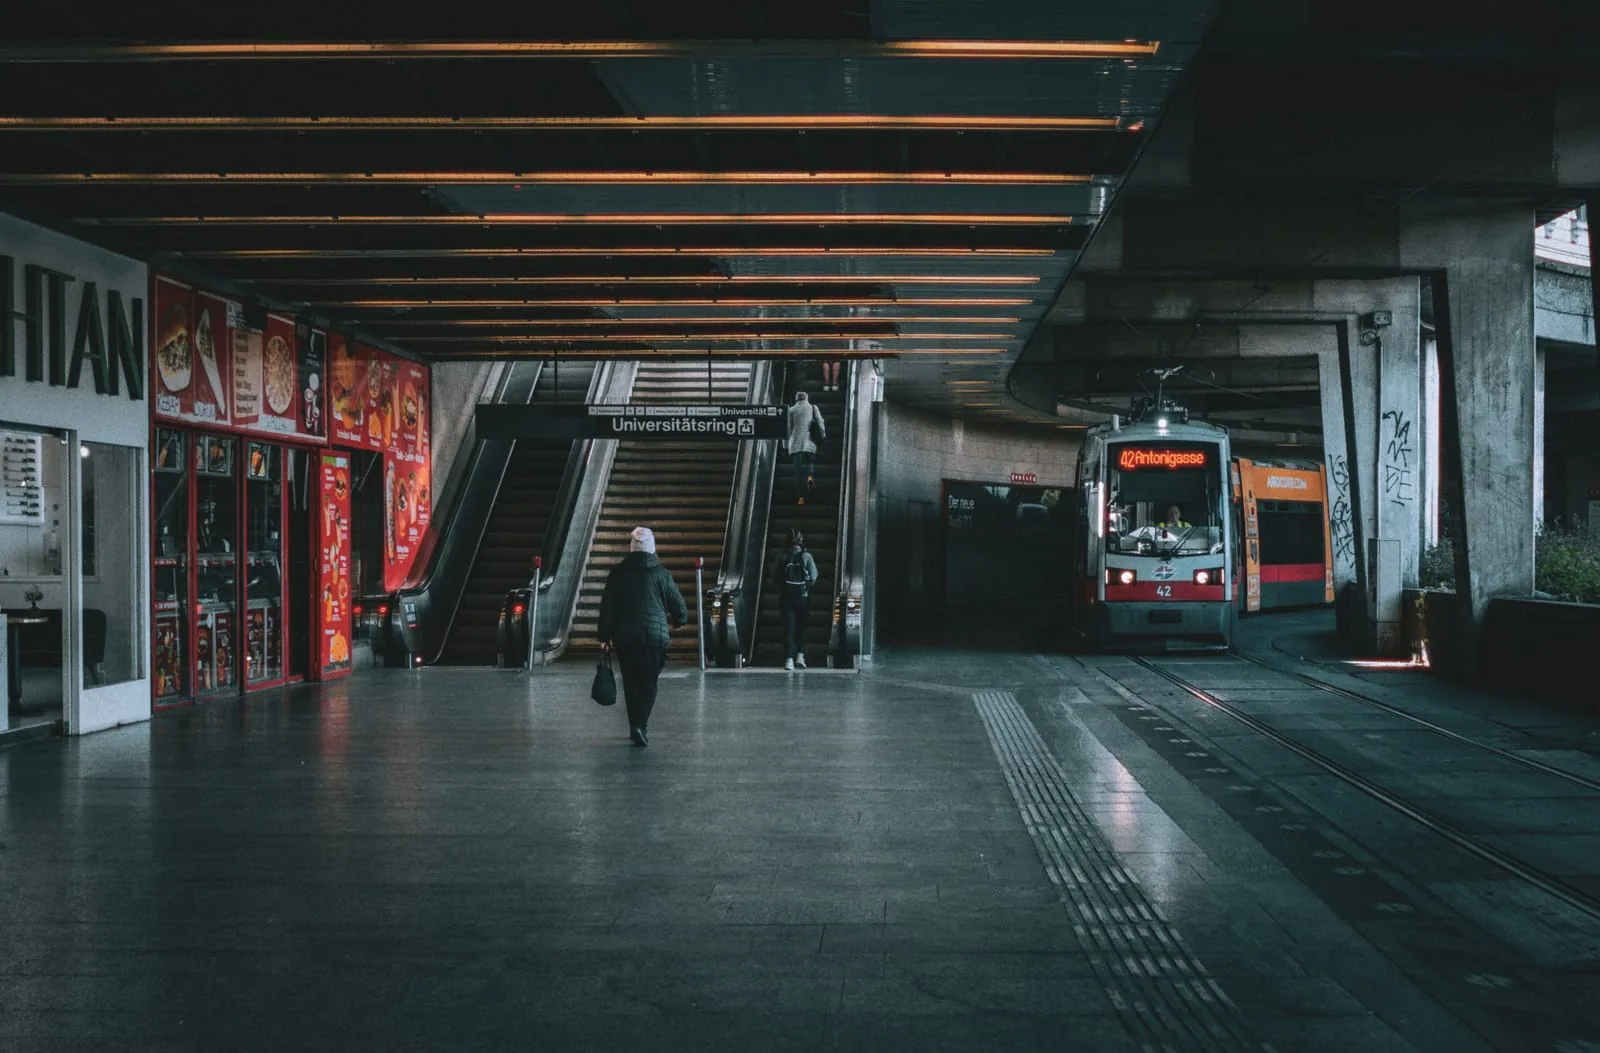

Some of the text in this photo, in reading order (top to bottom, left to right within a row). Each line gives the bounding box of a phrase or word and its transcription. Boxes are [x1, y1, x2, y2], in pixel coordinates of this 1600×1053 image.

[721, 407, 767, 416] Universität
[612, 417, 736, 435] Universitätsring
[1120, 449, 1204, 468] 42 Antonigasse
[1156, 585, 1172, 597] 42
